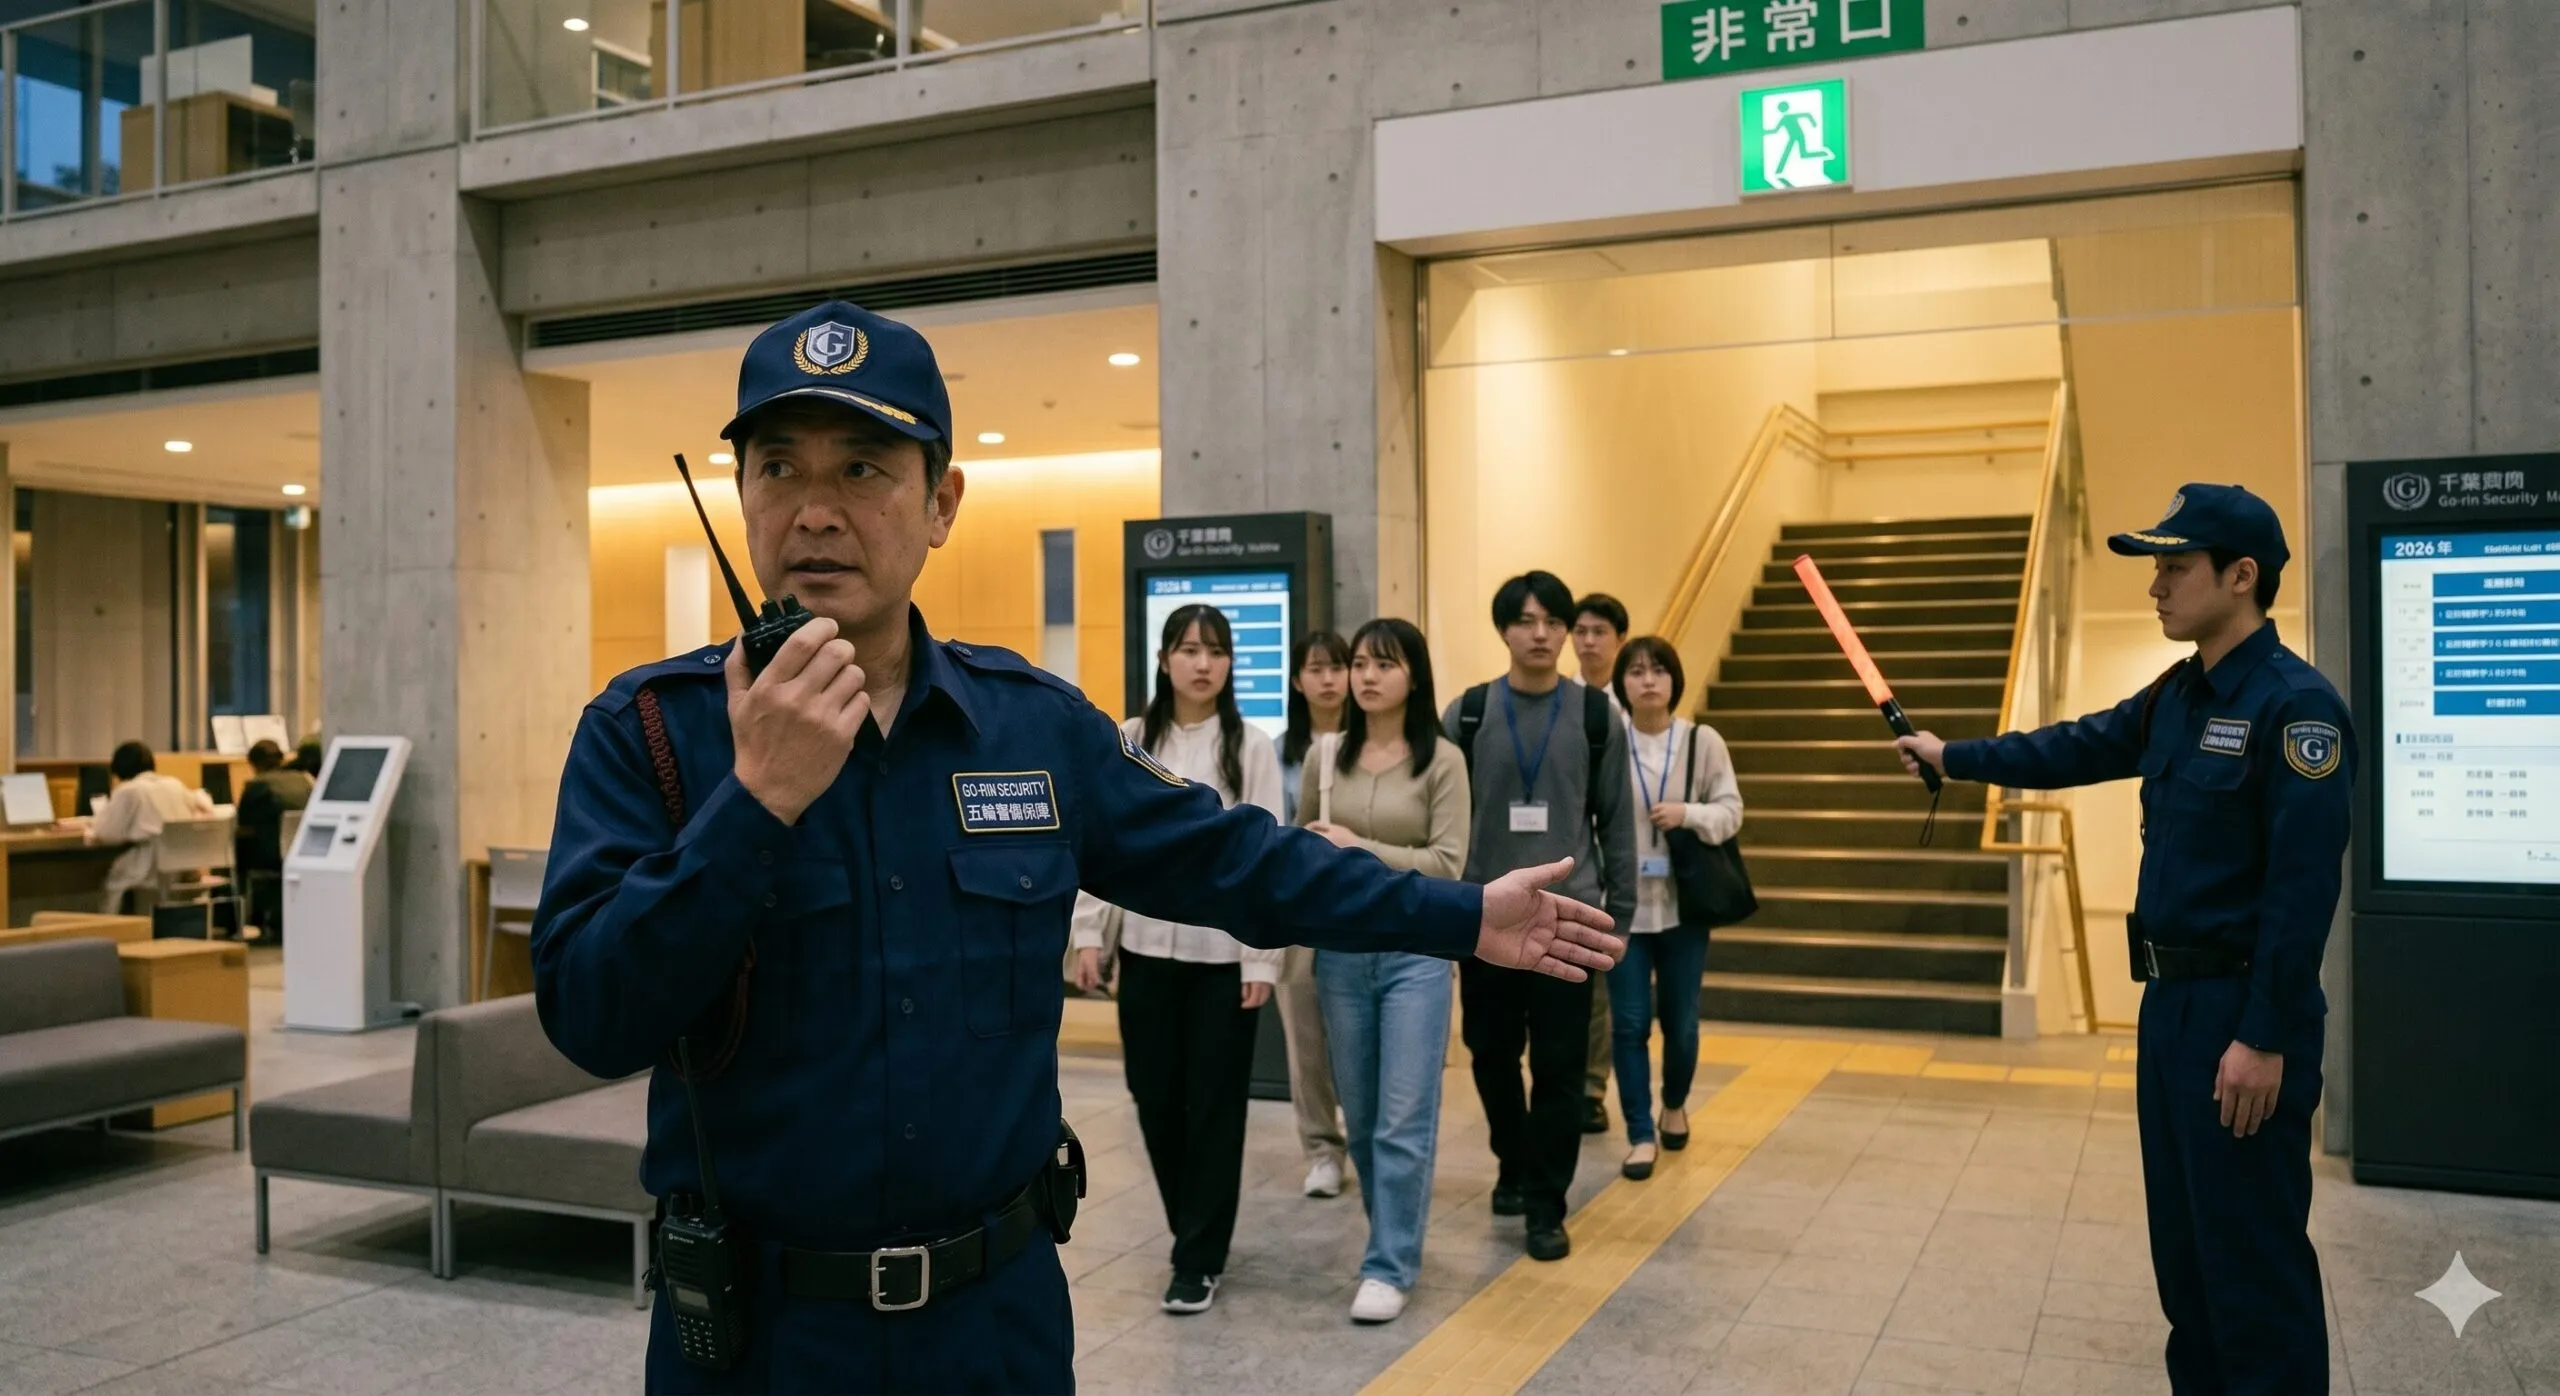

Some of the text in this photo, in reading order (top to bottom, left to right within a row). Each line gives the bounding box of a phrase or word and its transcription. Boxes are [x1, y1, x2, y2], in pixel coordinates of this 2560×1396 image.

[1691, 0, 1891, 63] 非常口
[2482, 491, 2539, 507] Security
[2301, 738, 2325, 760] G
[962, 781, 1045, 797] GO-RIN SECURITY
